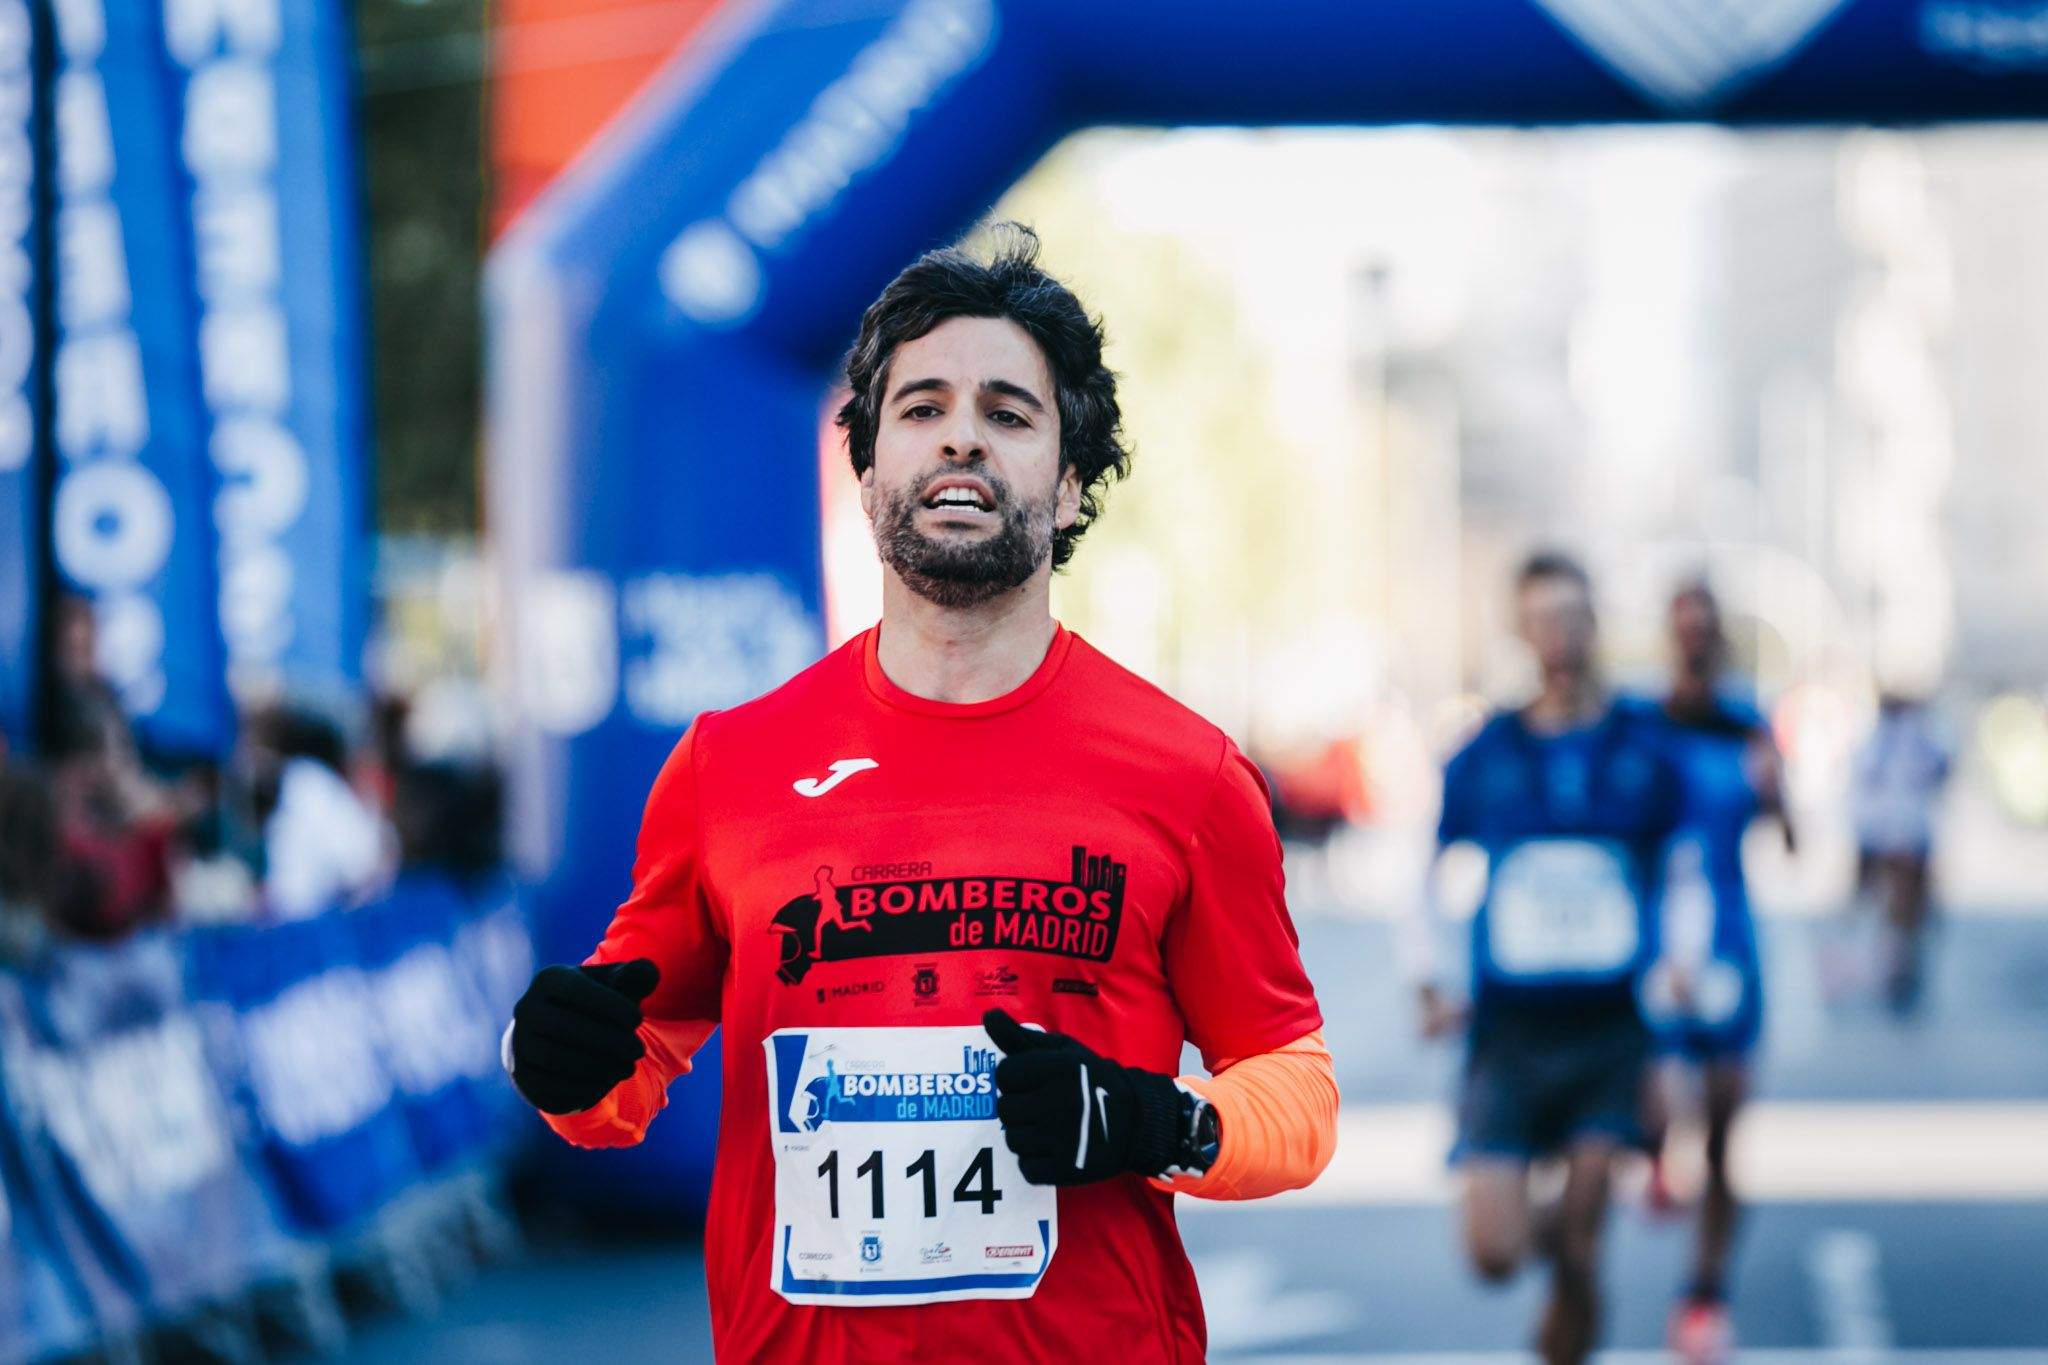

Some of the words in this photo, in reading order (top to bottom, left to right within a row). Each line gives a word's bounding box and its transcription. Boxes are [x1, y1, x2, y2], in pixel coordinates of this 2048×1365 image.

[851, 861, 932, 881] CARRERA
[851, 880, 1112, 921] BOMBEROS
[950, 912, 984, 946] de
[994, 911, 1109, 956] MADRID
[832, 981, 885, 996] MADRID
[843, 1073, 992, 1097] BOMBEROS
[896, 1096, 917, 1119] de
[924, 1096, 993, 1118] MADRID
[817, 1147, 1003, 1219] 1114
